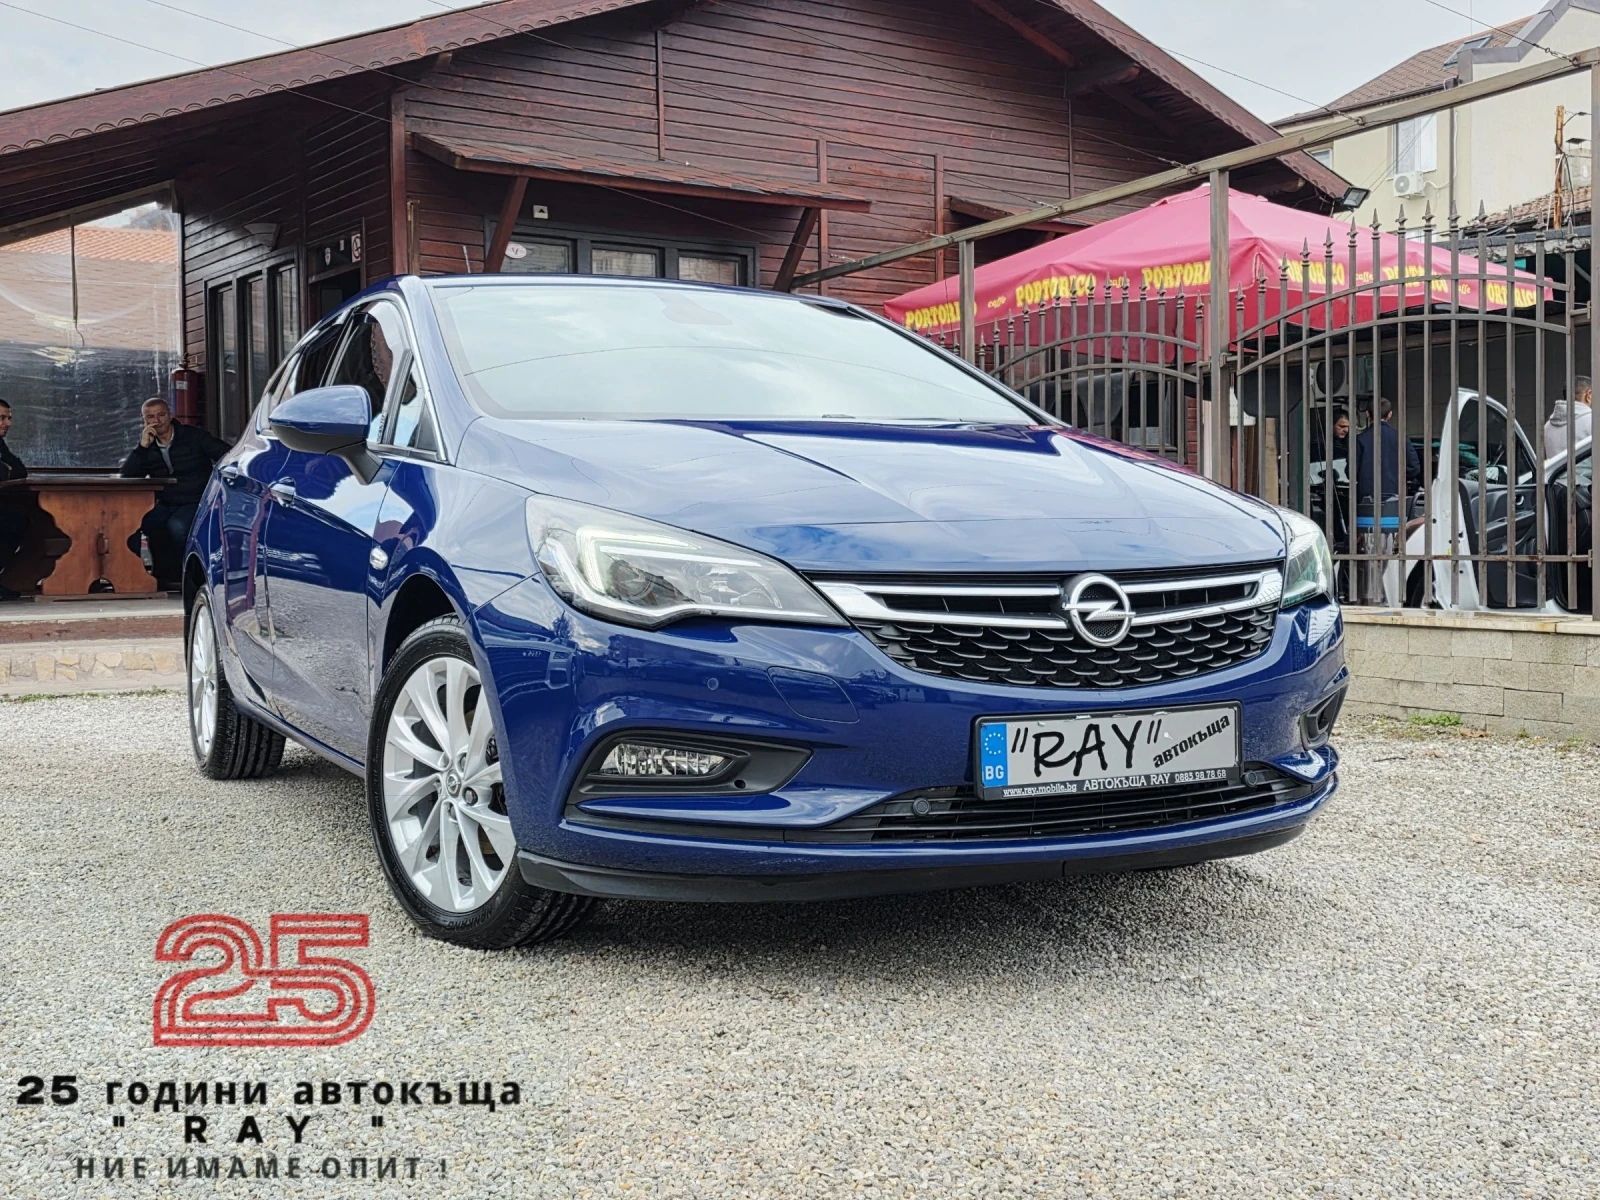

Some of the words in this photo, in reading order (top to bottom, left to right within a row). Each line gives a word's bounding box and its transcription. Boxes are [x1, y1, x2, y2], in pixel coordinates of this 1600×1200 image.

[1141, 260, 1212, 291] PORTORI
[1153, 715, 1231, 769] автокъща
[985, 765, 1004, 780] BG
[1003, 782, 1077, 797] www.ray.mobile.bg
[1150, 773, 1170, 785] RAY
